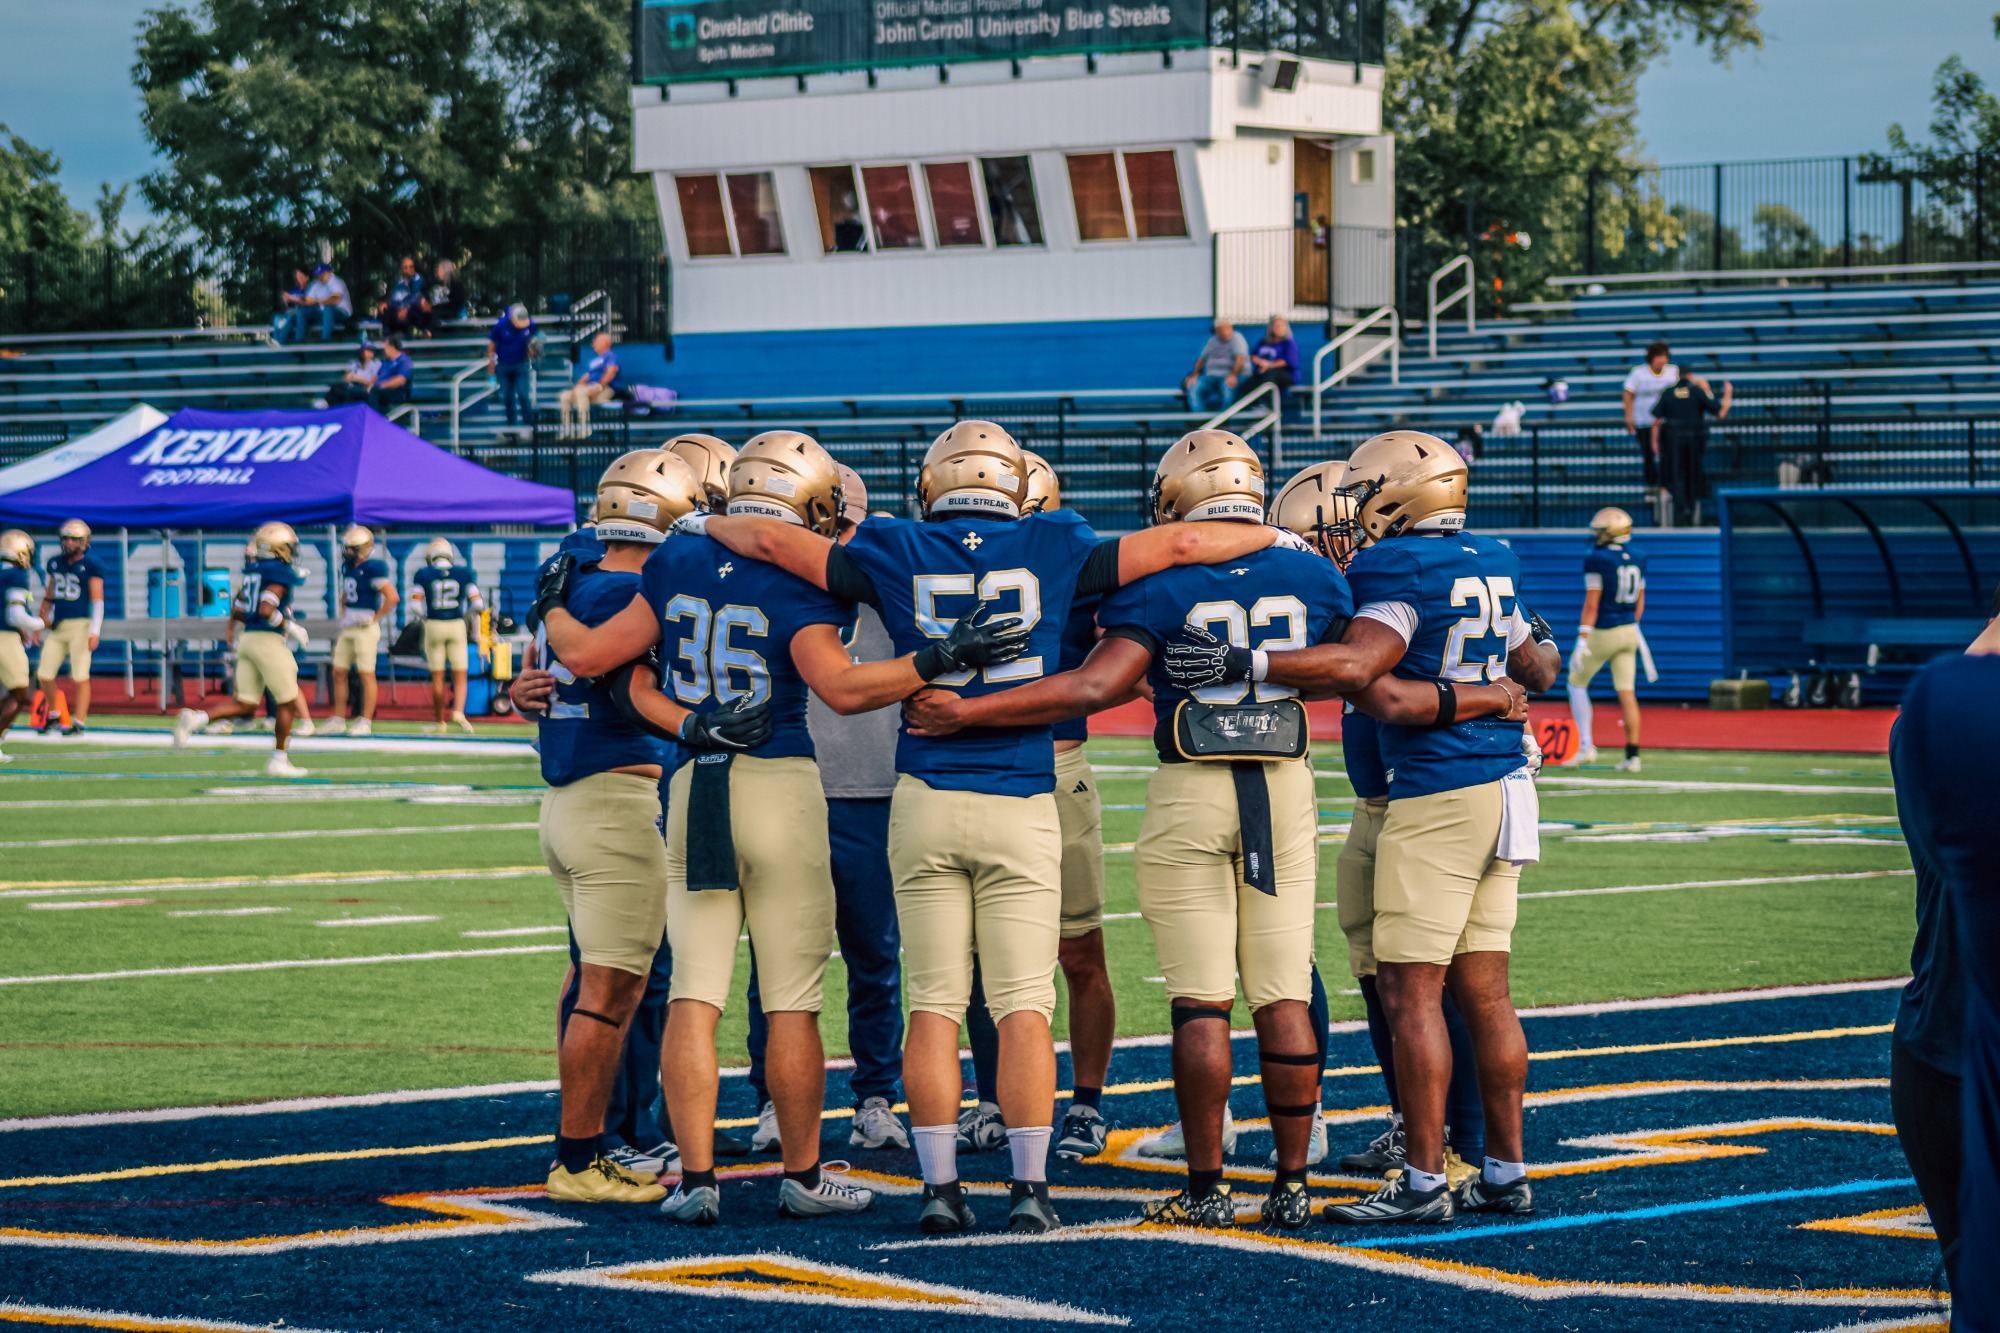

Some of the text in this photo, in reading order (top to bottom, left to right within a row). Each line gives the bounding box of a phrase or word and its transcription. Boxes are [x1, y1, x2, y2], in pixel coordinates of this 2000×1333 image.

[876, 0, 919, 18] Official
[923, 0, 972, 15] Medical
[876, 4, 1171, 44] John Carroll University Blue Streaks
[700, 12, 814, 40] Cleveland Clinic
[729, 44, 775, 59] Medicine
[128, 422, 343, 466] KENYON
[140, 467, 255, 487] FOOTBALL
[730, 505, 782, 517] BLUE STREAKS
[949, 497, 1010, 510] BLUE STREAKS
[1207, 505, 1230, 515] BLUE
[610, 529, 646, 539] STREAKS
[53, 571, 82, 602] 26
[431, 578, 460, 610] 12
[1615, 565, 1642, 604] 10
[913, 567, 1044, 687] 52
[1439, 576, 1516, 683] 25
[665, 593, 772, 709] 36
[1540, 724, 1571, 760] 20
